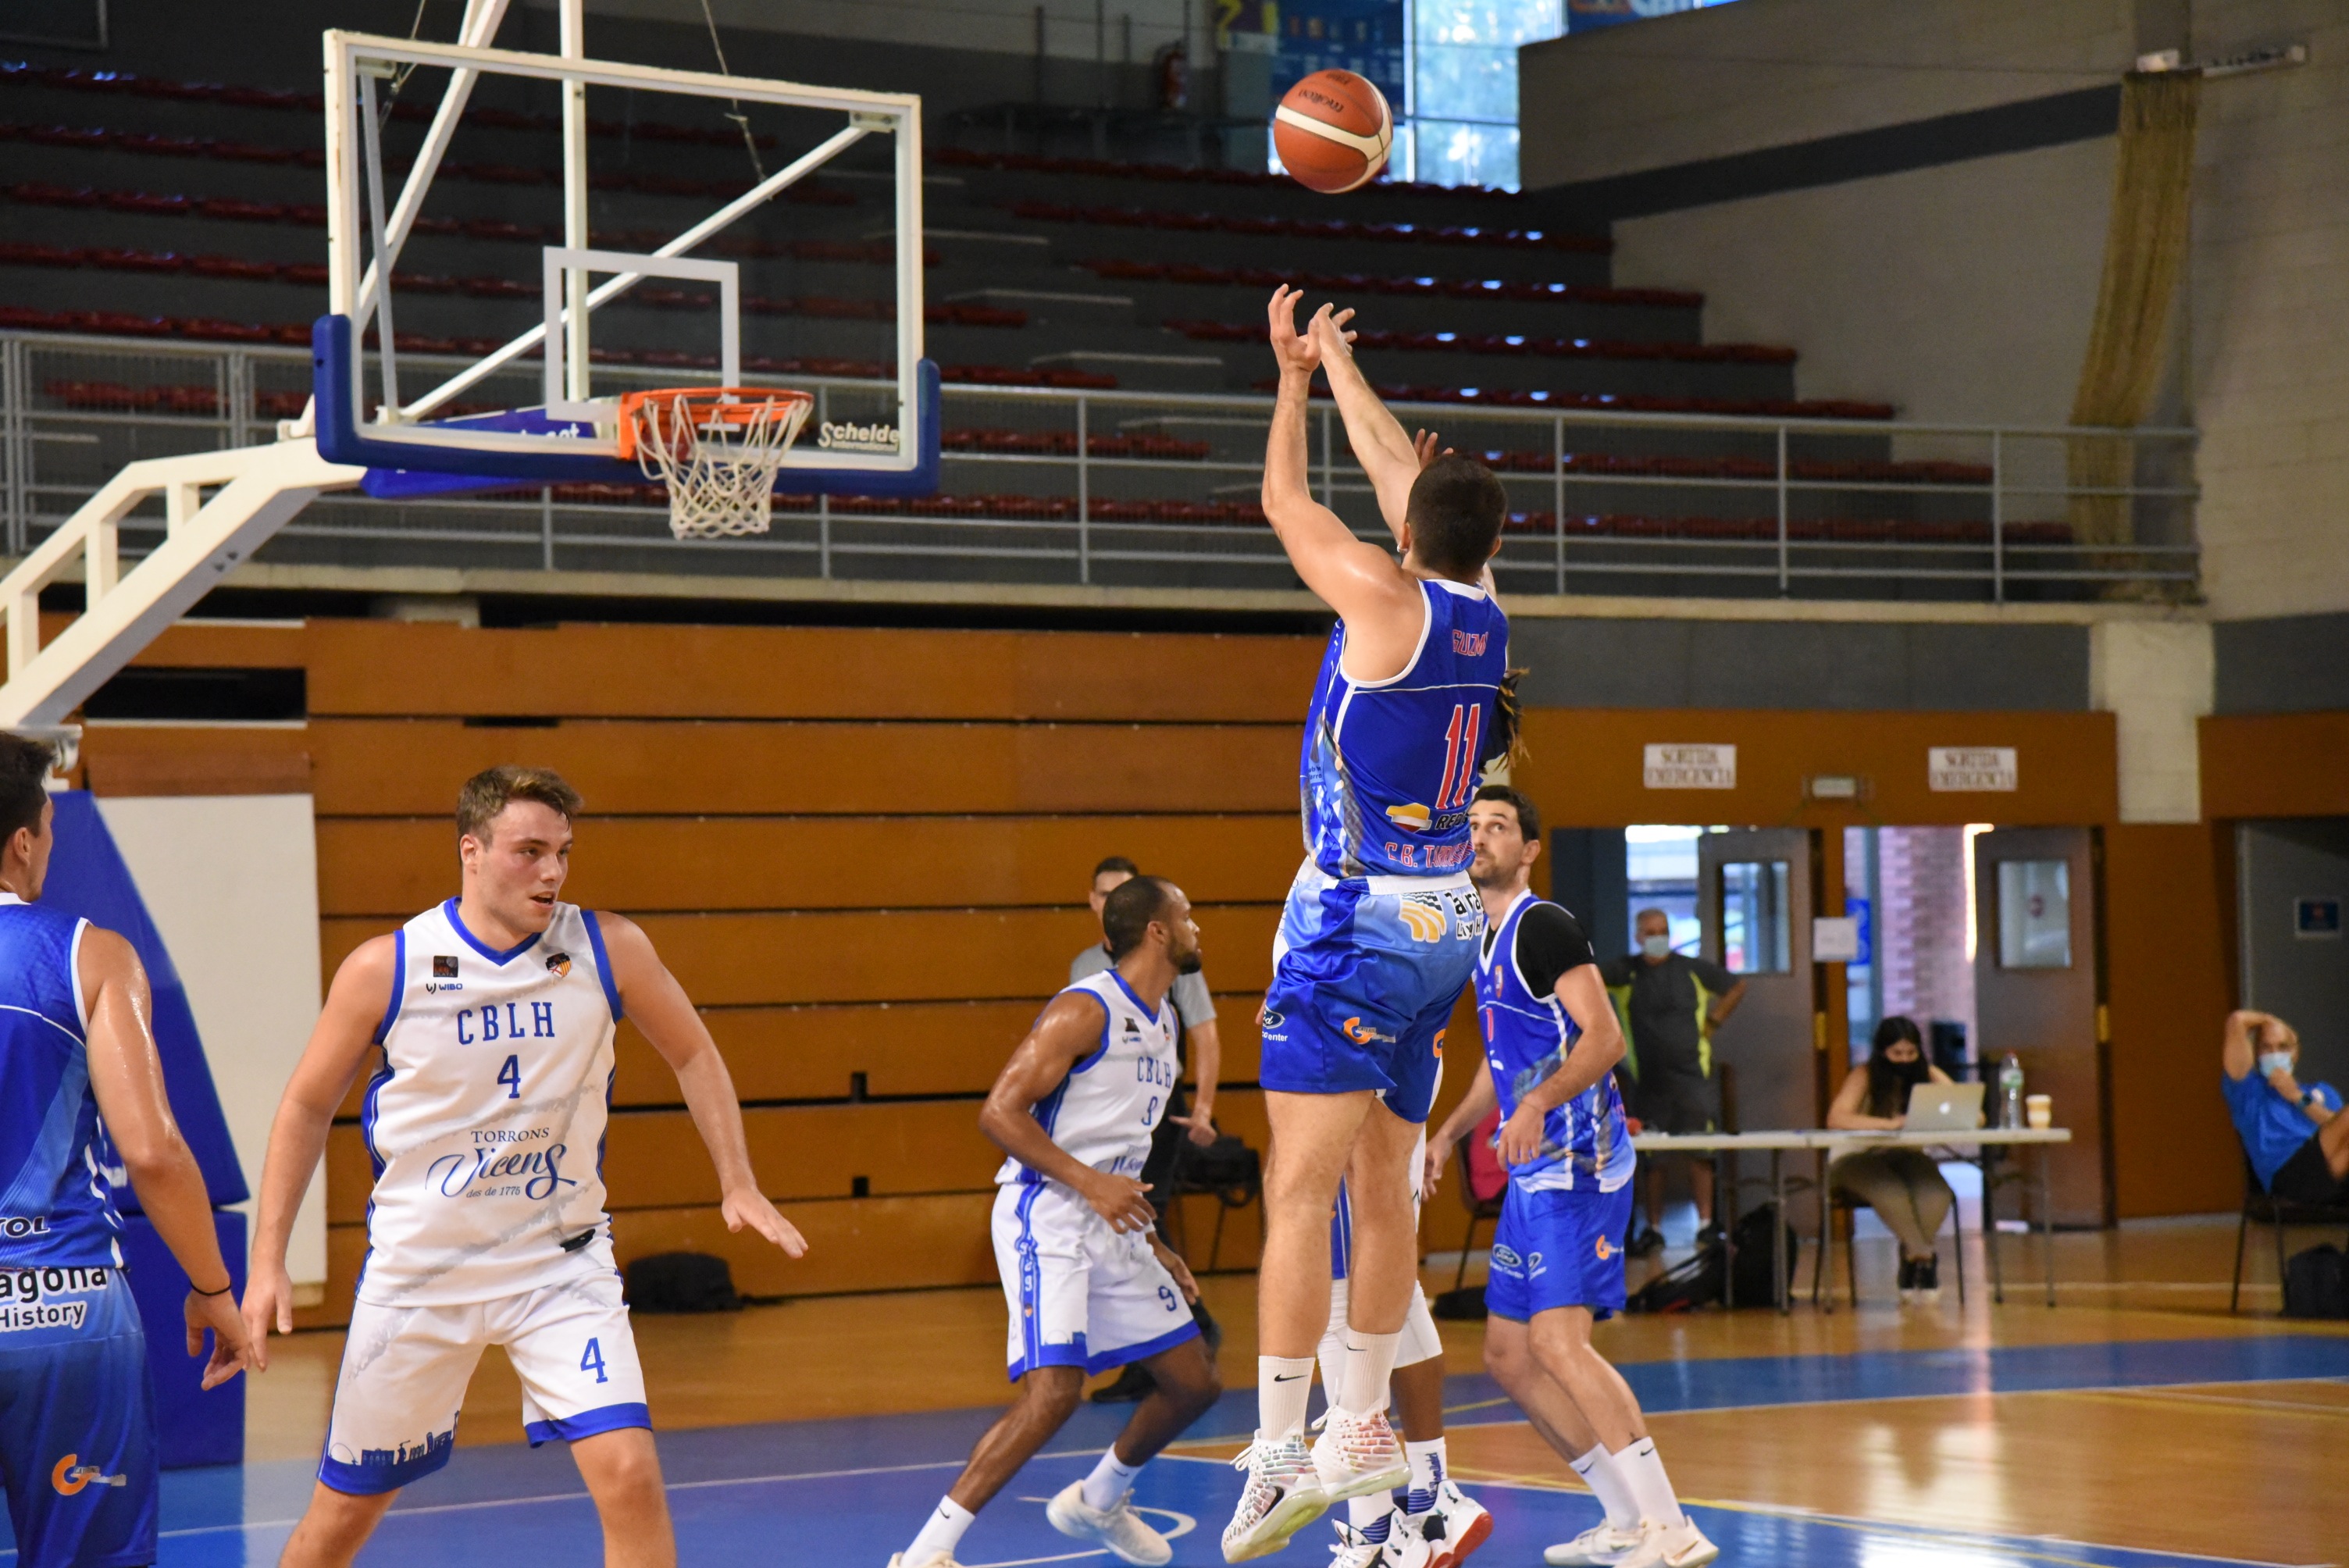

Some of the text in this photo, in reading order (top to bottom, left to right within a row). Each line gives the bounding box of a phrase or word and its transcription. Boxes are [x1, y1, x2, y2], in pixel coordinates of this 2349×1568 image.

[818, 422, 900, 448] Schelde
[1453, 629, 1488, 656] GUZM
[1435, 704, 1481, 810] 11
[458, 1002, 555, 1045] CBLH
[497, 1054, 521, 1099] 4
[1137, 1056, 1171, 1089] CBLH
[471, 1128, 550, 1143] TORRONS
[425, 1144, 577, 1200] Vicens
[466, 1188, 481, 1198] des
[484, 1186, 497, 1196] de
[1158, 1285, 1177, 1312] 9
[0, 1305, 84, 1327] History
[580, 1337, 608, 1384] 4
